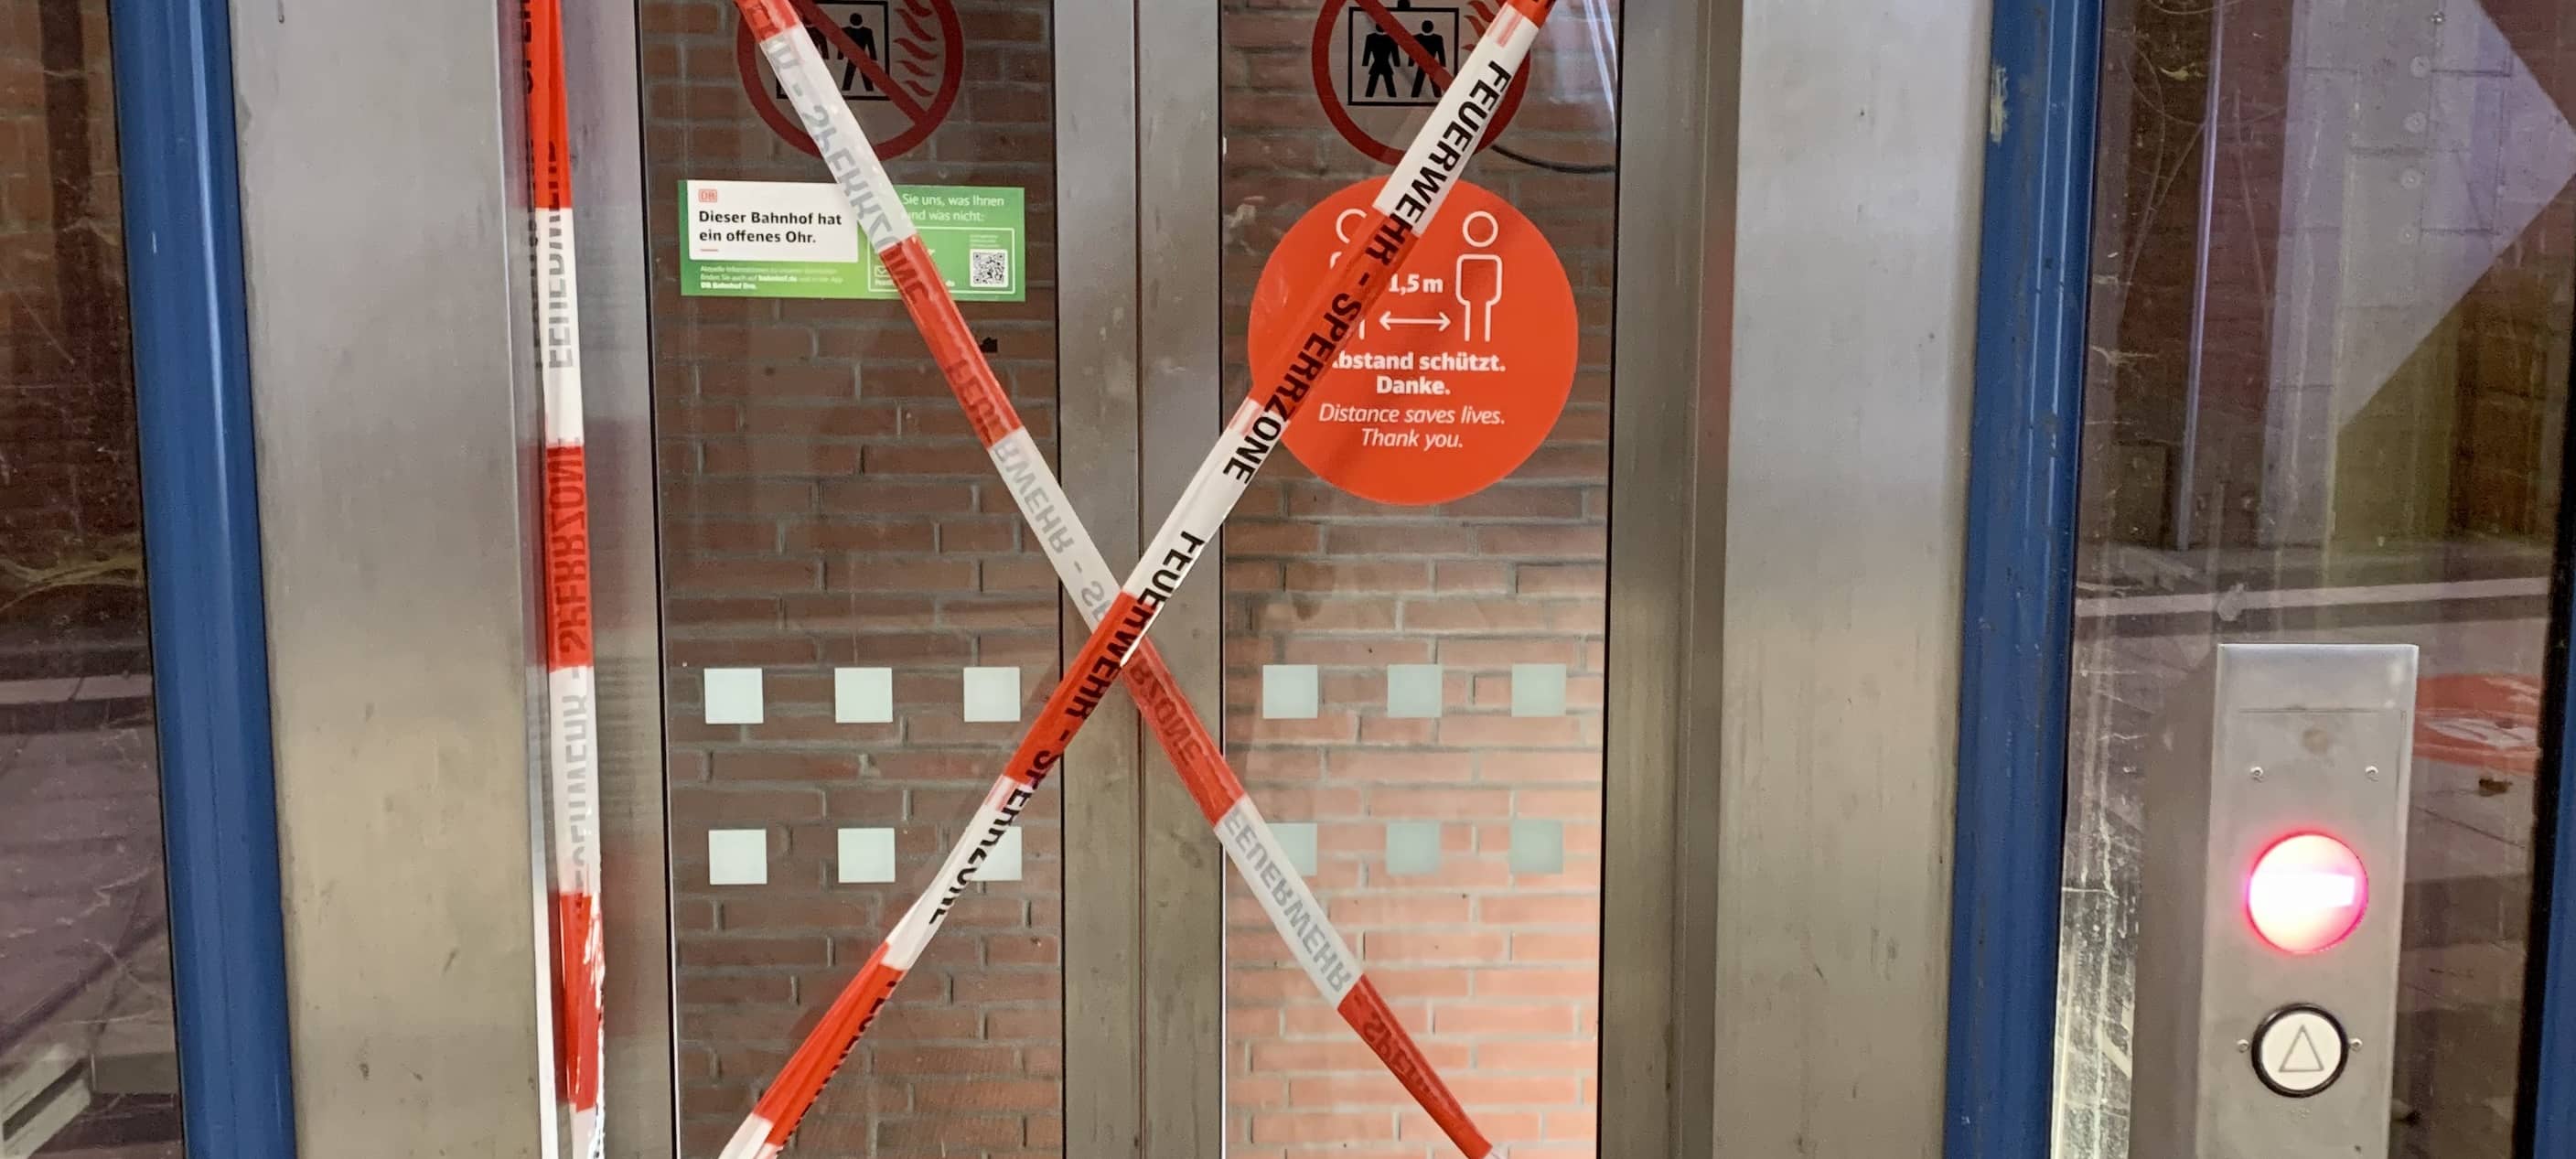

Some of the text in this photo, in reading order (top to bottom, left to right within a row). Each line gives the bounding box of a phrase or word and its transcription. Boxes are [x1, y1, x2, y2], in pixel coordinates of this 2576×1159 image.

[1365, 60, 1512, 265] FEUERWEHR
[902, 193, 1004, 207] Sie uns, was Ihnen
[699, 211, 842, 225] Dieser Bahnhof hat
[928, 211, 951, 220] was
[953, 210, 985, 221] nicht:
[699, 230, 816, 243] ein offenes Ohr.
[1388, 274, 1444, 295] 1,5 m
[1419, 352, 1506, 371] schützt.
[1223, 292, 1363, 485] SPERRZONE
[1377, 377, 1450, 395] Danke.
[1318, 403, 1505, 425] Distance saves lives.
[1361, 428, 1464, 452] Thank you.
